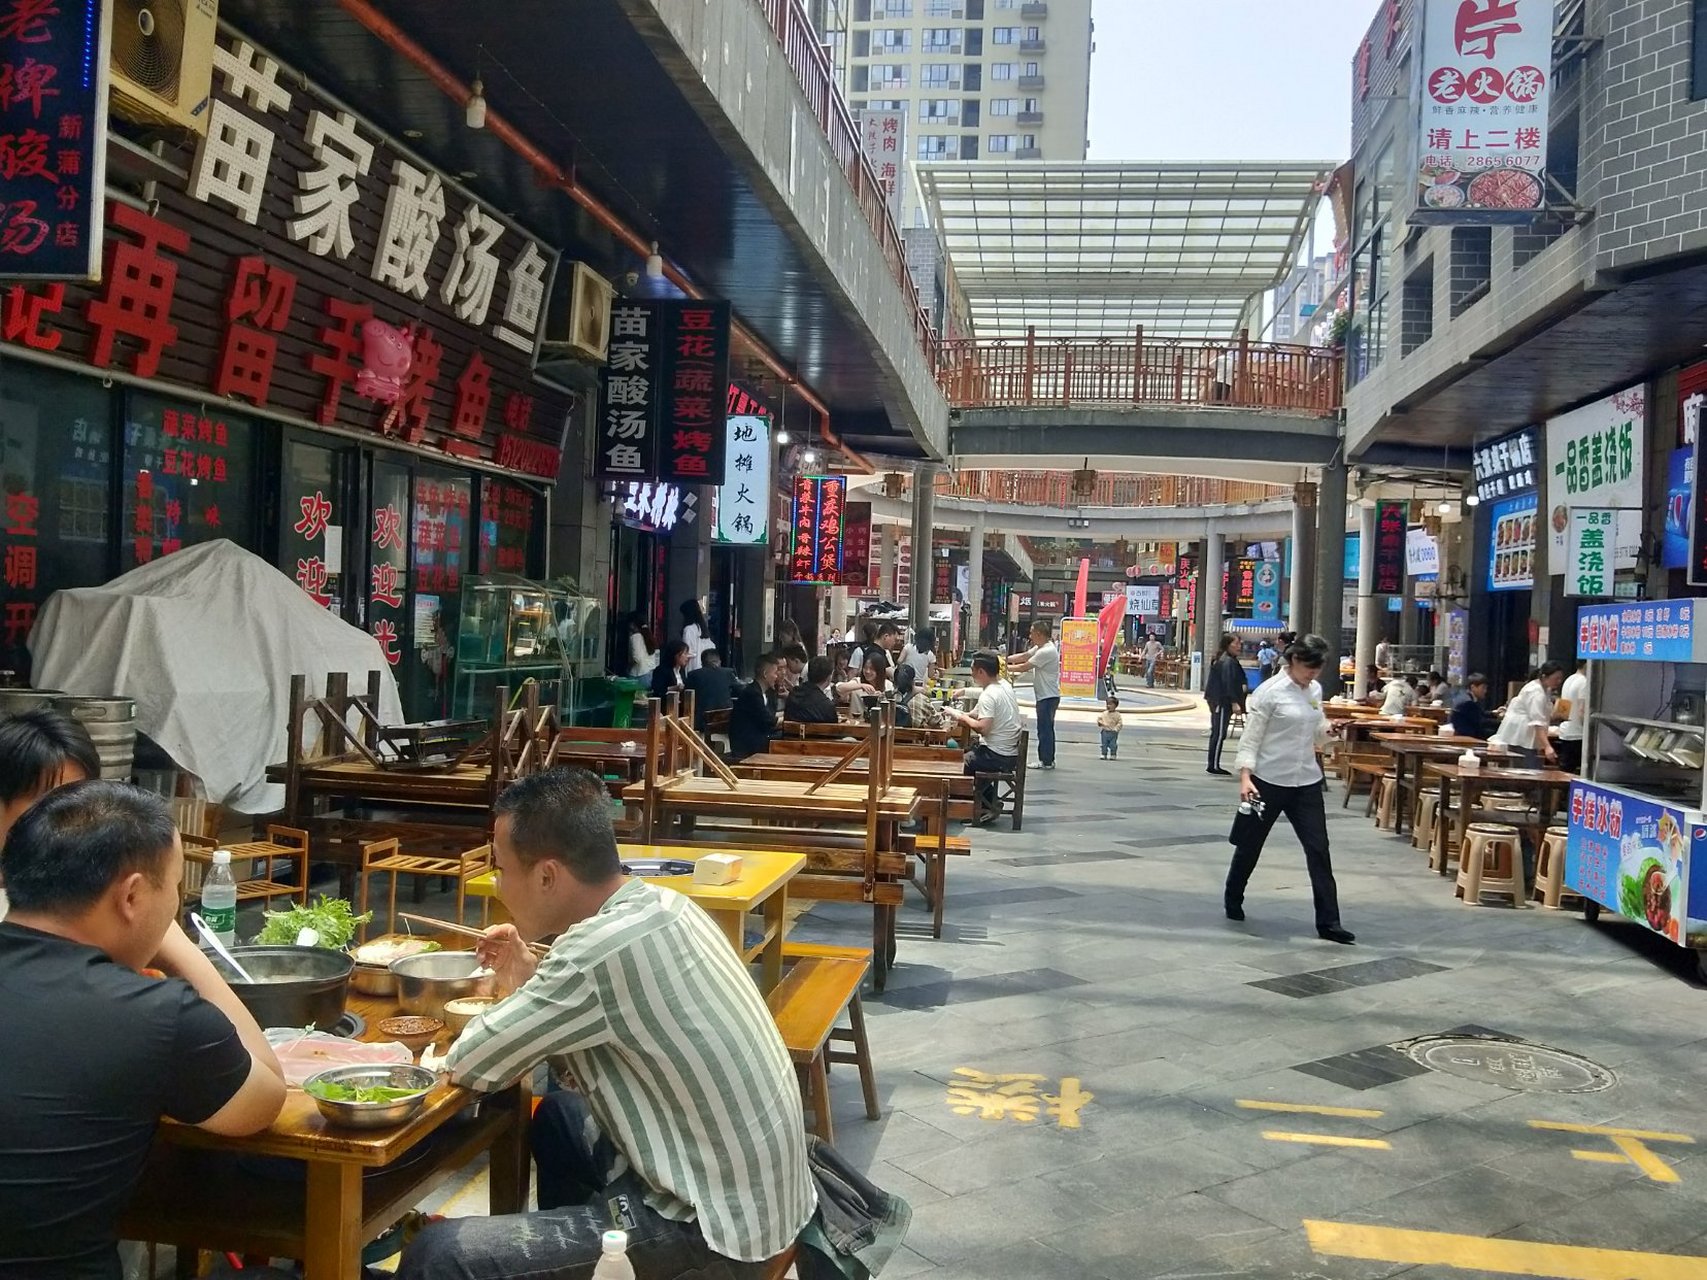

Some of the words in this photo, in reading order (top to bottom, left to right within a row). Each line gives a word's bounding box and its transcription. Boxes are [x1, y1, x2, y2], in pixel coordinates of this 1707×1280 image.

[1432, 68, 1544, 100] 老火锅
[1426, 127, 1541, 150] 请上二楼
[188, 40, 549, 354] 苗家酸汤鱼
[605, 306, 652, 474] 苗家酸汤鱼
[732, 425, 758, 535] 地摊火锅
[1577, 528, 1605, 595] 盖浇饭
